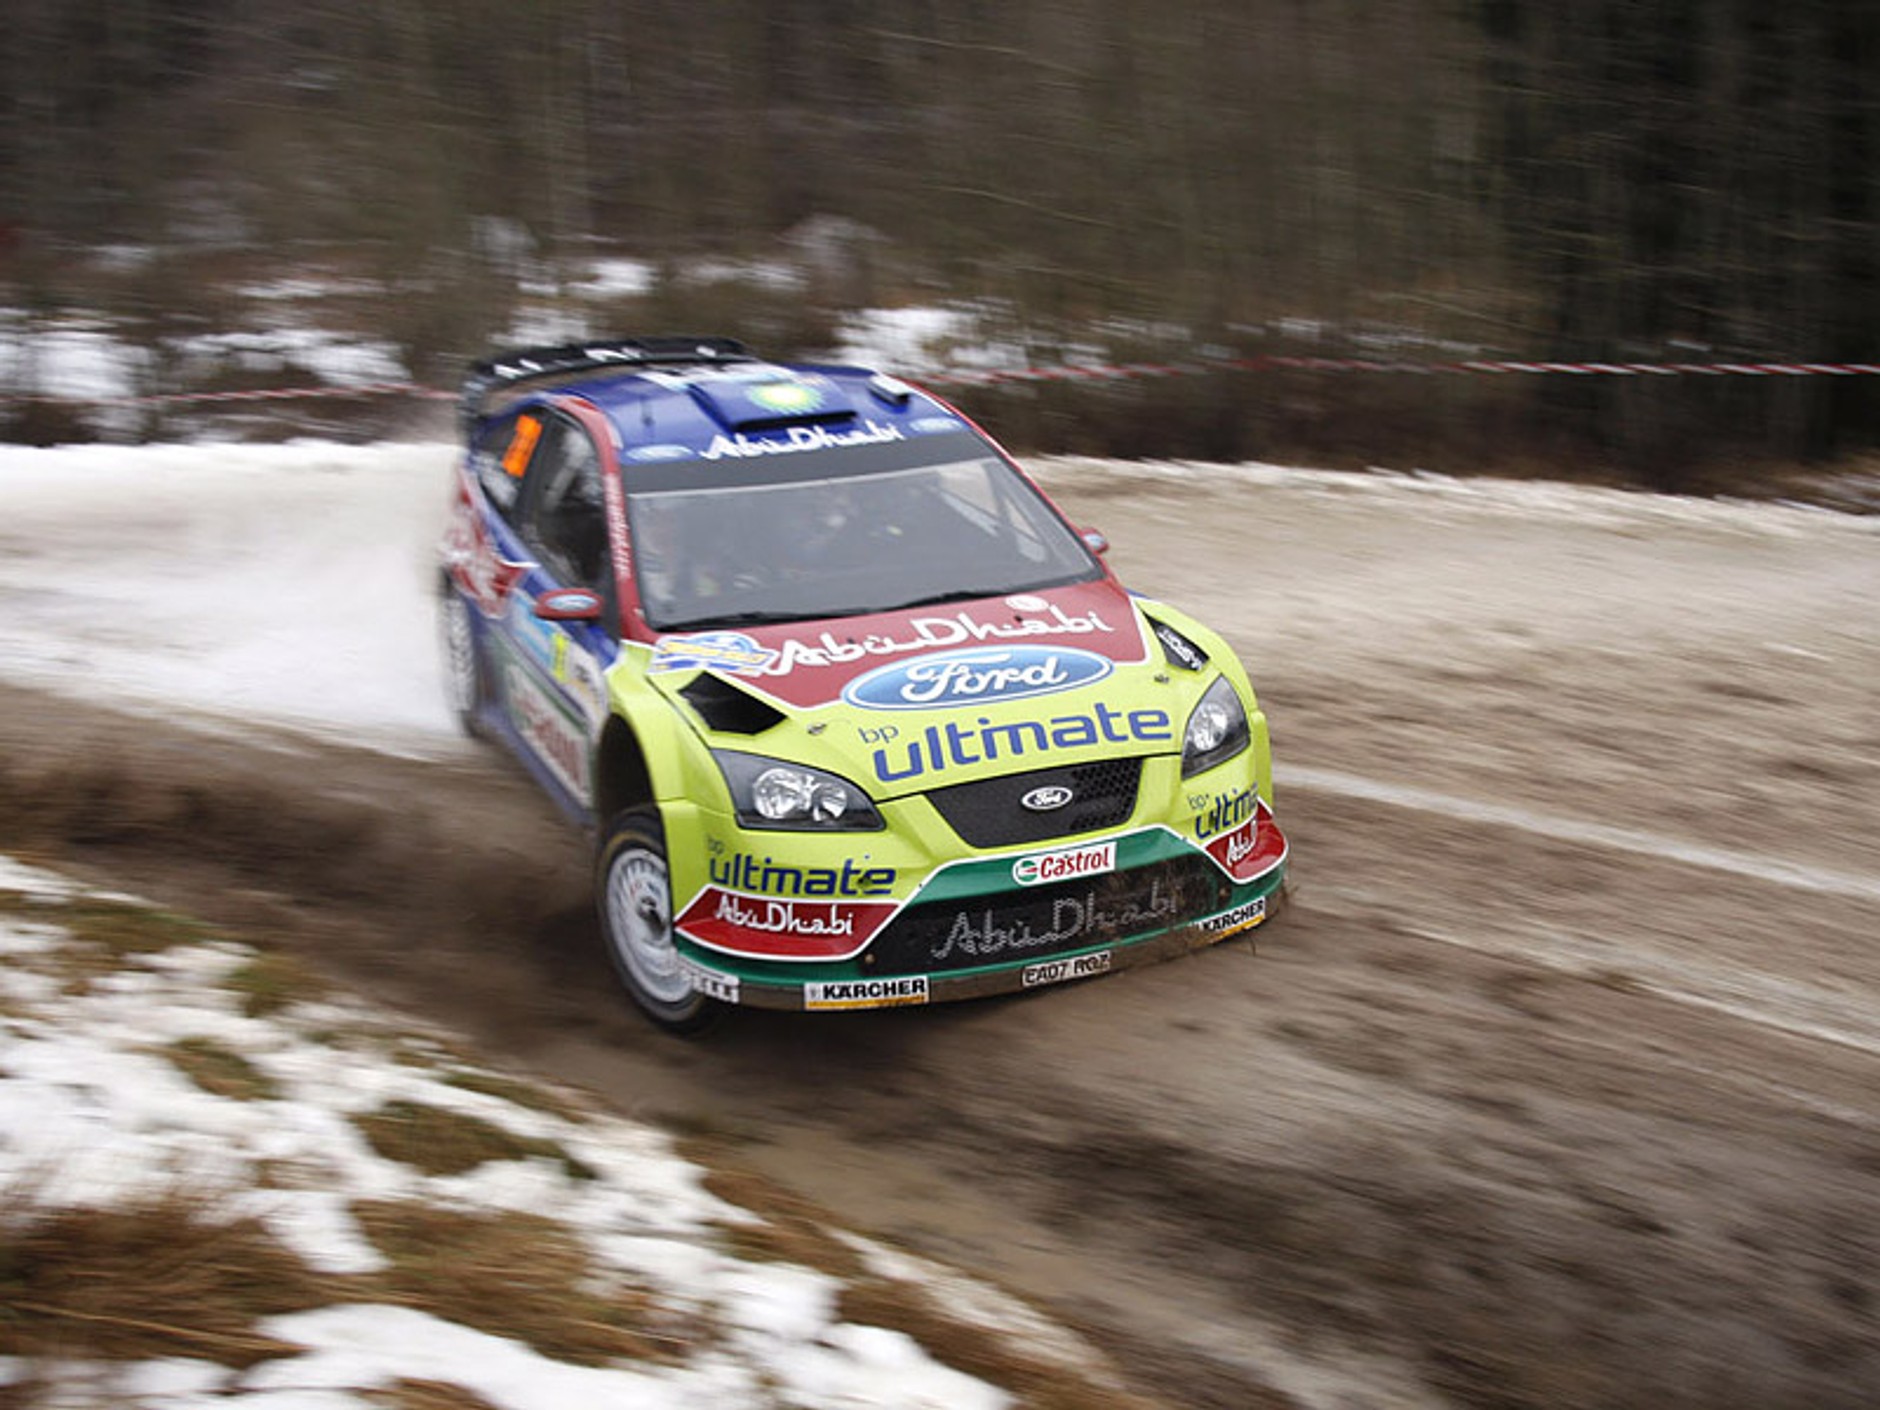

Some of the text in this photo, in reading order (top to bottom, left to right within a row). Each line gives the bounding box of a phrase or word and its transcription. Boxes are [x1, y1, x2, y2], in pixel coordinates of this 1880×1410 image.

[901, 652, 1067, 701] Ford
[858, 724, 899, 744] bp
[873, 703, 1172, 782] ultimate
[710, 853, 897, 895] ultimate
[1040, 846, 1110, 880] Castrol
